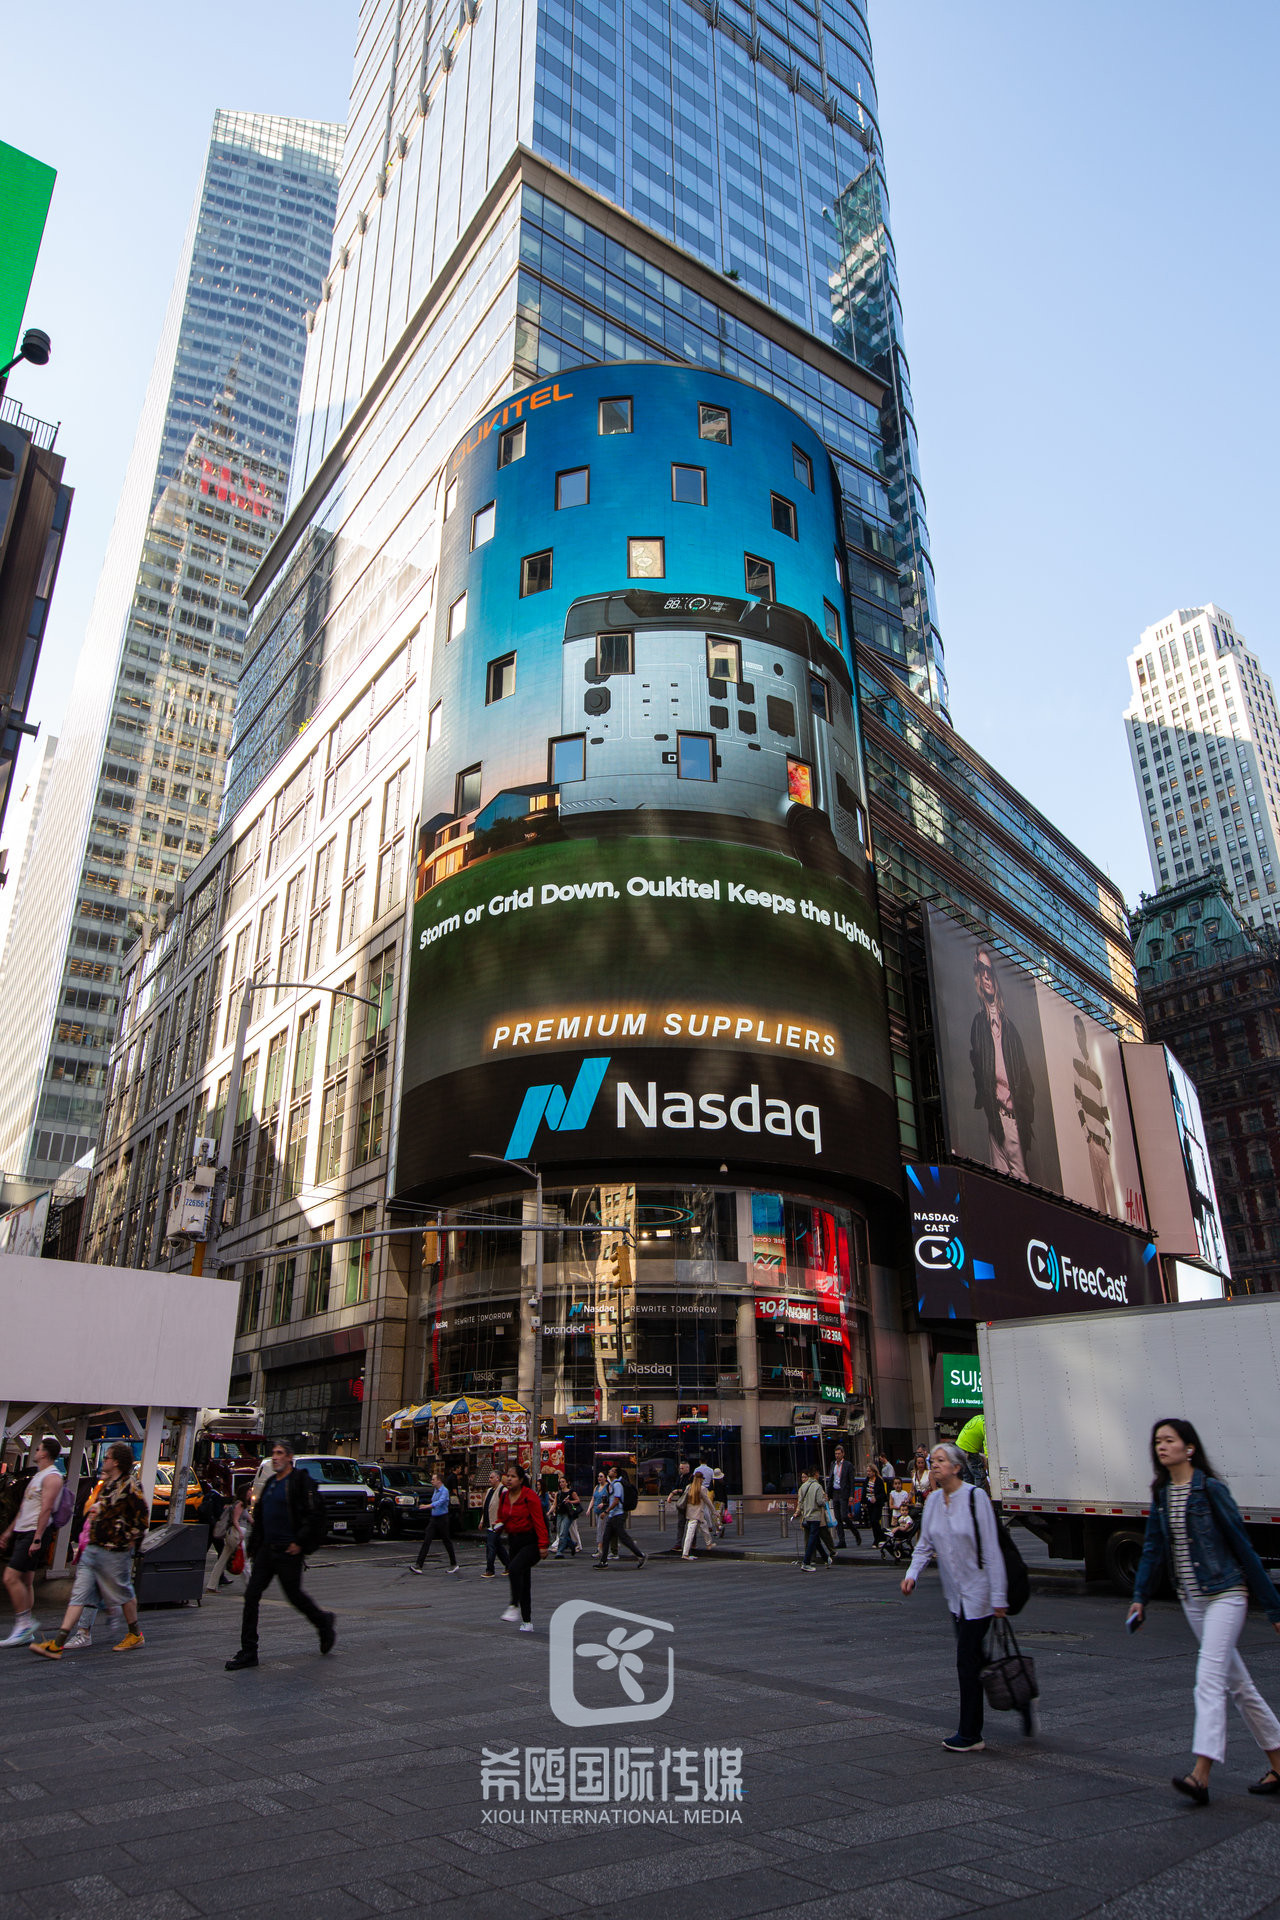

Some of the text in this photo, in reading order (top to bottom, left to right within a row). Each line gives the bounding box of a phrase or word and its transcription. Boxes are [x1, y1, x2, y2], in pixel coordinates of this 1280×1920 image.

[419, 914, 460, 950] Storm
[464, 904, 485, 925] or
[488, 887, 533, 916] Grid
[541, 881, 620, 905] Down,
[627, 876, 720, 900] Oukitel
[727, 882, 796, 914] Keeps
[800, 899, 831, 926] the
[834, 911, 870, 951] Lights
[492, 1013, 835, 1056] PREMIUM SUPPLIERS
[616, 1081, 822, 1155] Nasdaq
[913, 1212, 959, 1224] NASDAQ:
[1125, 1187, 1145, 1228] H&M
[924, 1224, 950, 1233] CAST
[1061, 1255, 1129, 1304] FreeCast
[477, 1312, 513, 1322] TOMORROW
[583, 1304, 718, 1314] Nasdaq REWRITE TOMORROW
[627, 1363, 672, 1376] Nasdaq
